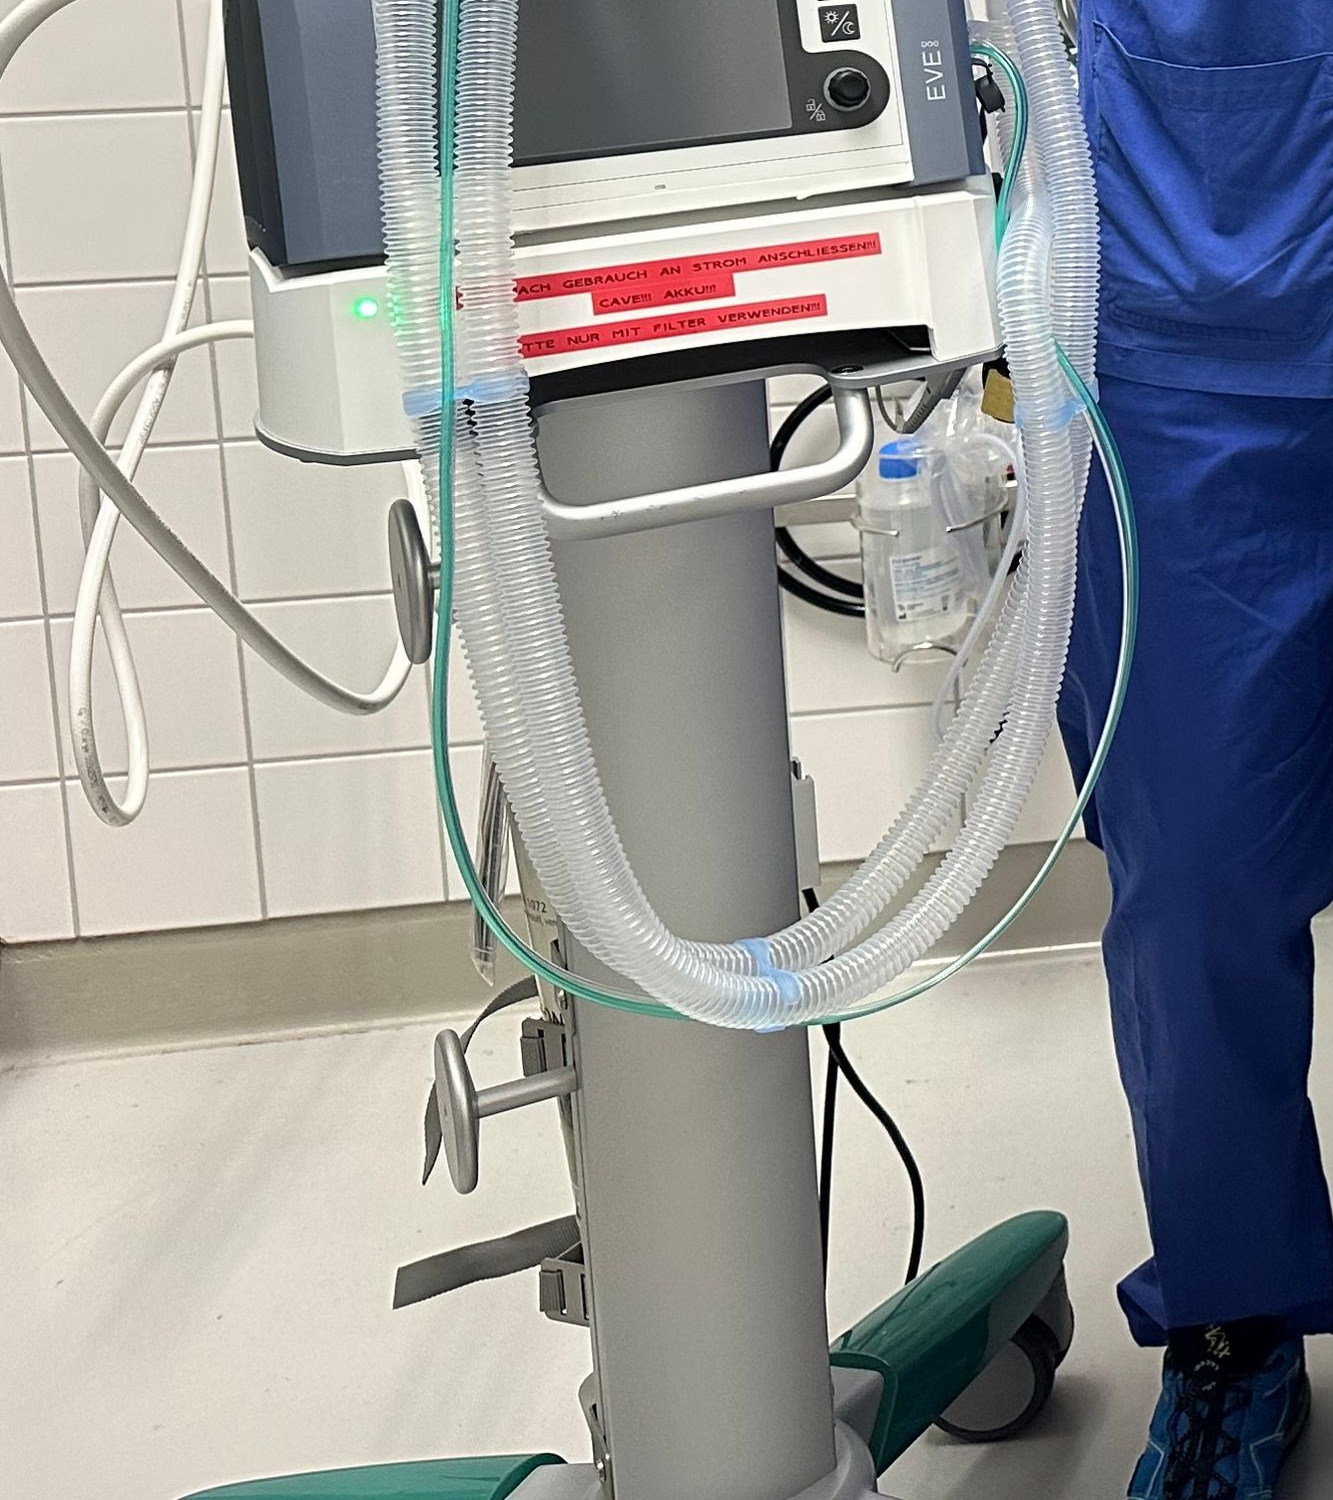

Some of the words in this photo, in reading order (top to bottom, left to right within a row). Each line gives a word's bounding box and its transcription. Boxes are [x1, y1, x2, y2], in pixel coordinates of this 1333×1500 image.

[518, 282, 551, 296] ACH
[562, 270, 648, 289] GEBRAUCH
[660, 264, 681, 277] AN
[692, 257, 747, 272] STROM
[758, 240, 876, 263] ANSCHLIESSEN!!!
[599, 292, 652, 308] CAVE!!!
[663, 283, 716, 299] AKKU!!!
[522, 338, 555, 352] TTE
[567, 332, 600, 346] NUR
[612, 326, 640, 339] MIT
[653, 316, 706, 332] FILTER
[718, 302, 820, 324] VERWENDEN!!!
